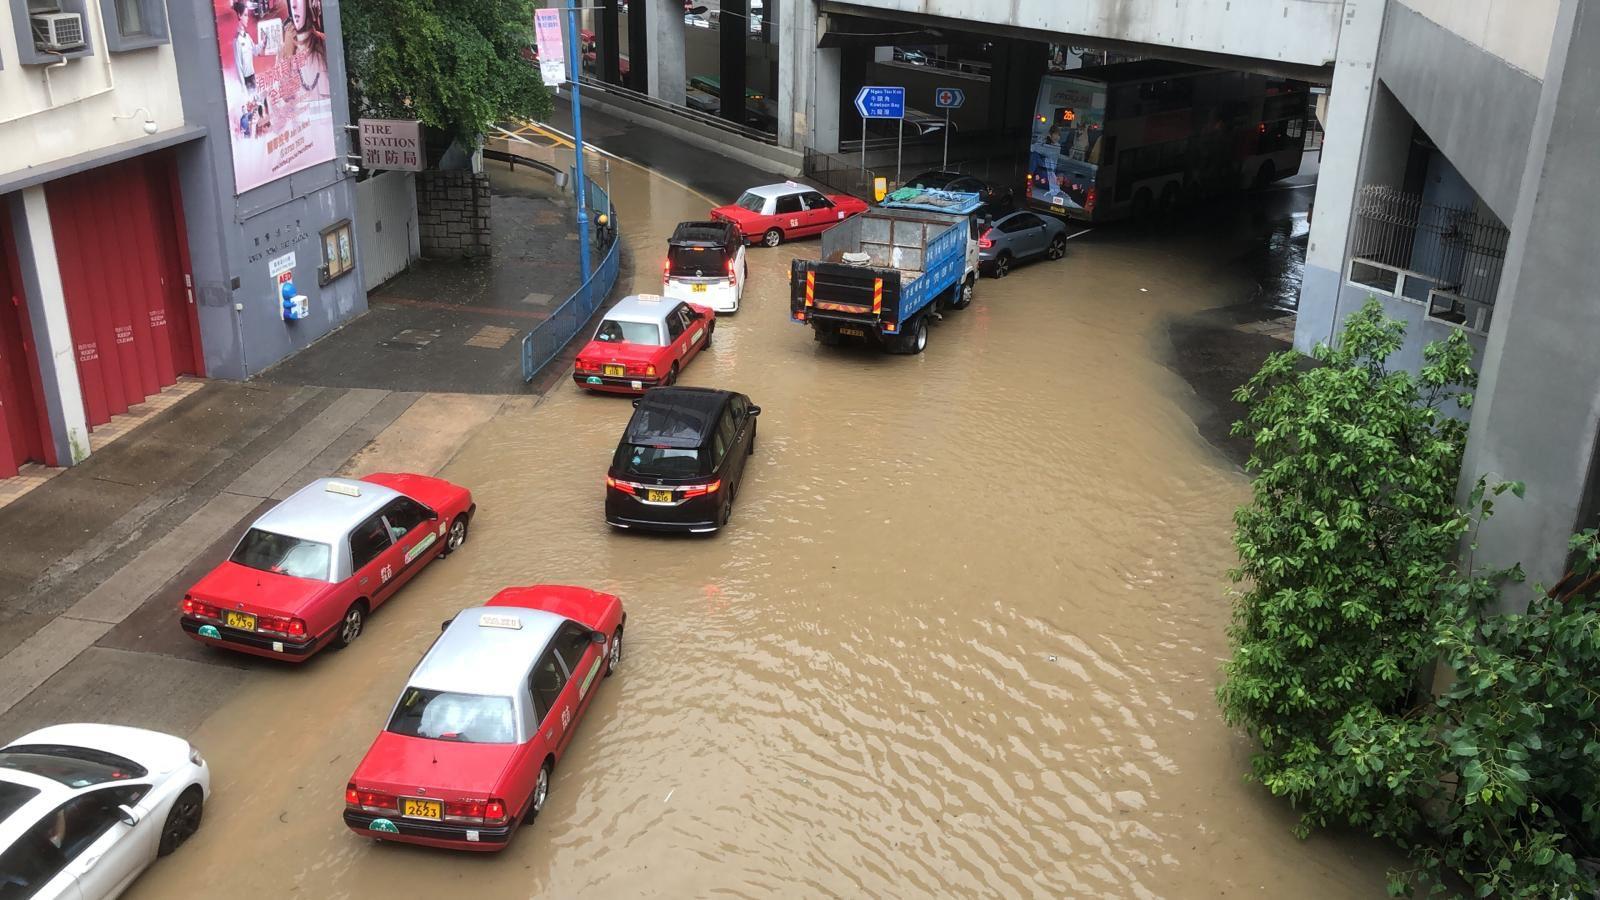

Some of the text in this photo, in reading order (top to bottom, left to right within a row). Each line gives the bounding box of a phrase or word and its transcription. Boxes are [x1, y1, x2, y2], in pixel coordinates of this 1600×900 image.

[364, 124, 392, 135] FIRE
[364, 136, 416, 148] STATION
[366, 149, 417, 166] 消防局
[280, 272, 292, 284] AED
[229, 618, 253, 629] 6739
[408, 806, 437, 818] 2623
